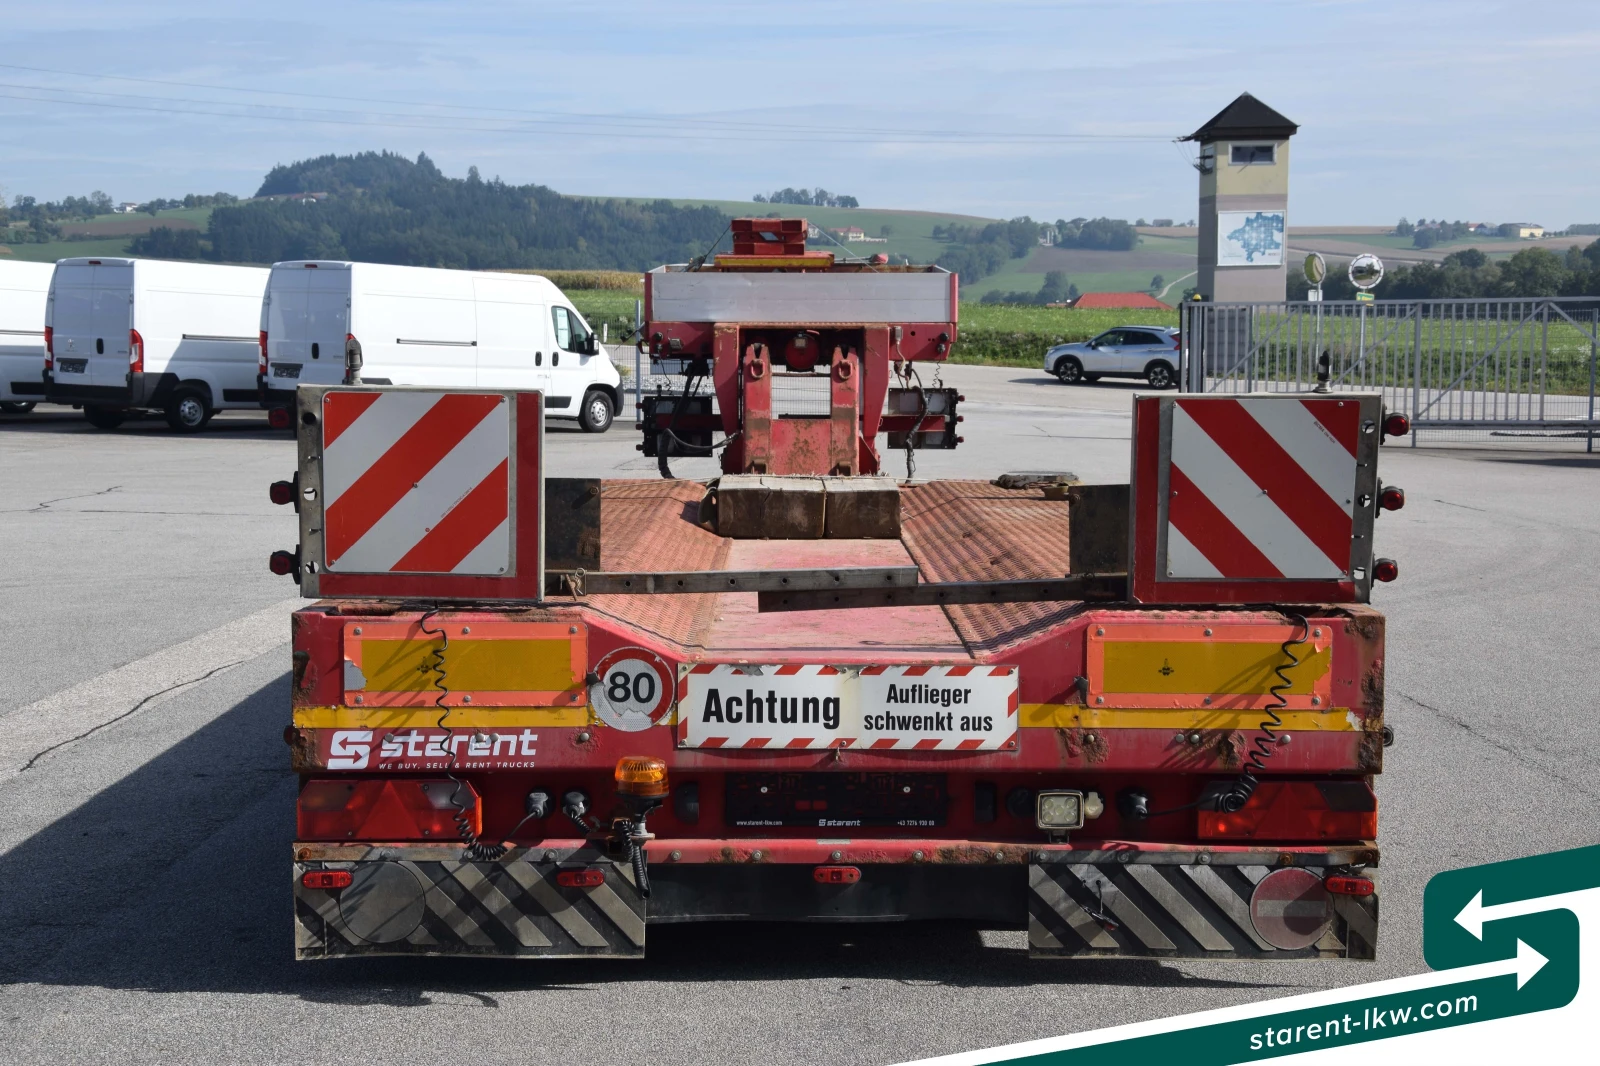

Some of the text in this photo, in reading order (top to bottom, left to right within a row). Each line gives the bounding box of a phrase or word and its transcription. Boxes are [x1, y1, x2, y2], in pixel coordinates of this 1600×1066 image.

[608, 671, 655, 704] 80
[886, 683, 972, 708] Auflieger
[702, 688, 840, 730] Achtung
[863, 711, 993, 732] schwenkt aus
[380, 728, 539, 758] starent
[397, 762, 421, 770] BUY,
[465, 761, 491, 769] RENT
[496, 761, 536, 769] TRUCKS
[827, 818, 861, 827] starent
